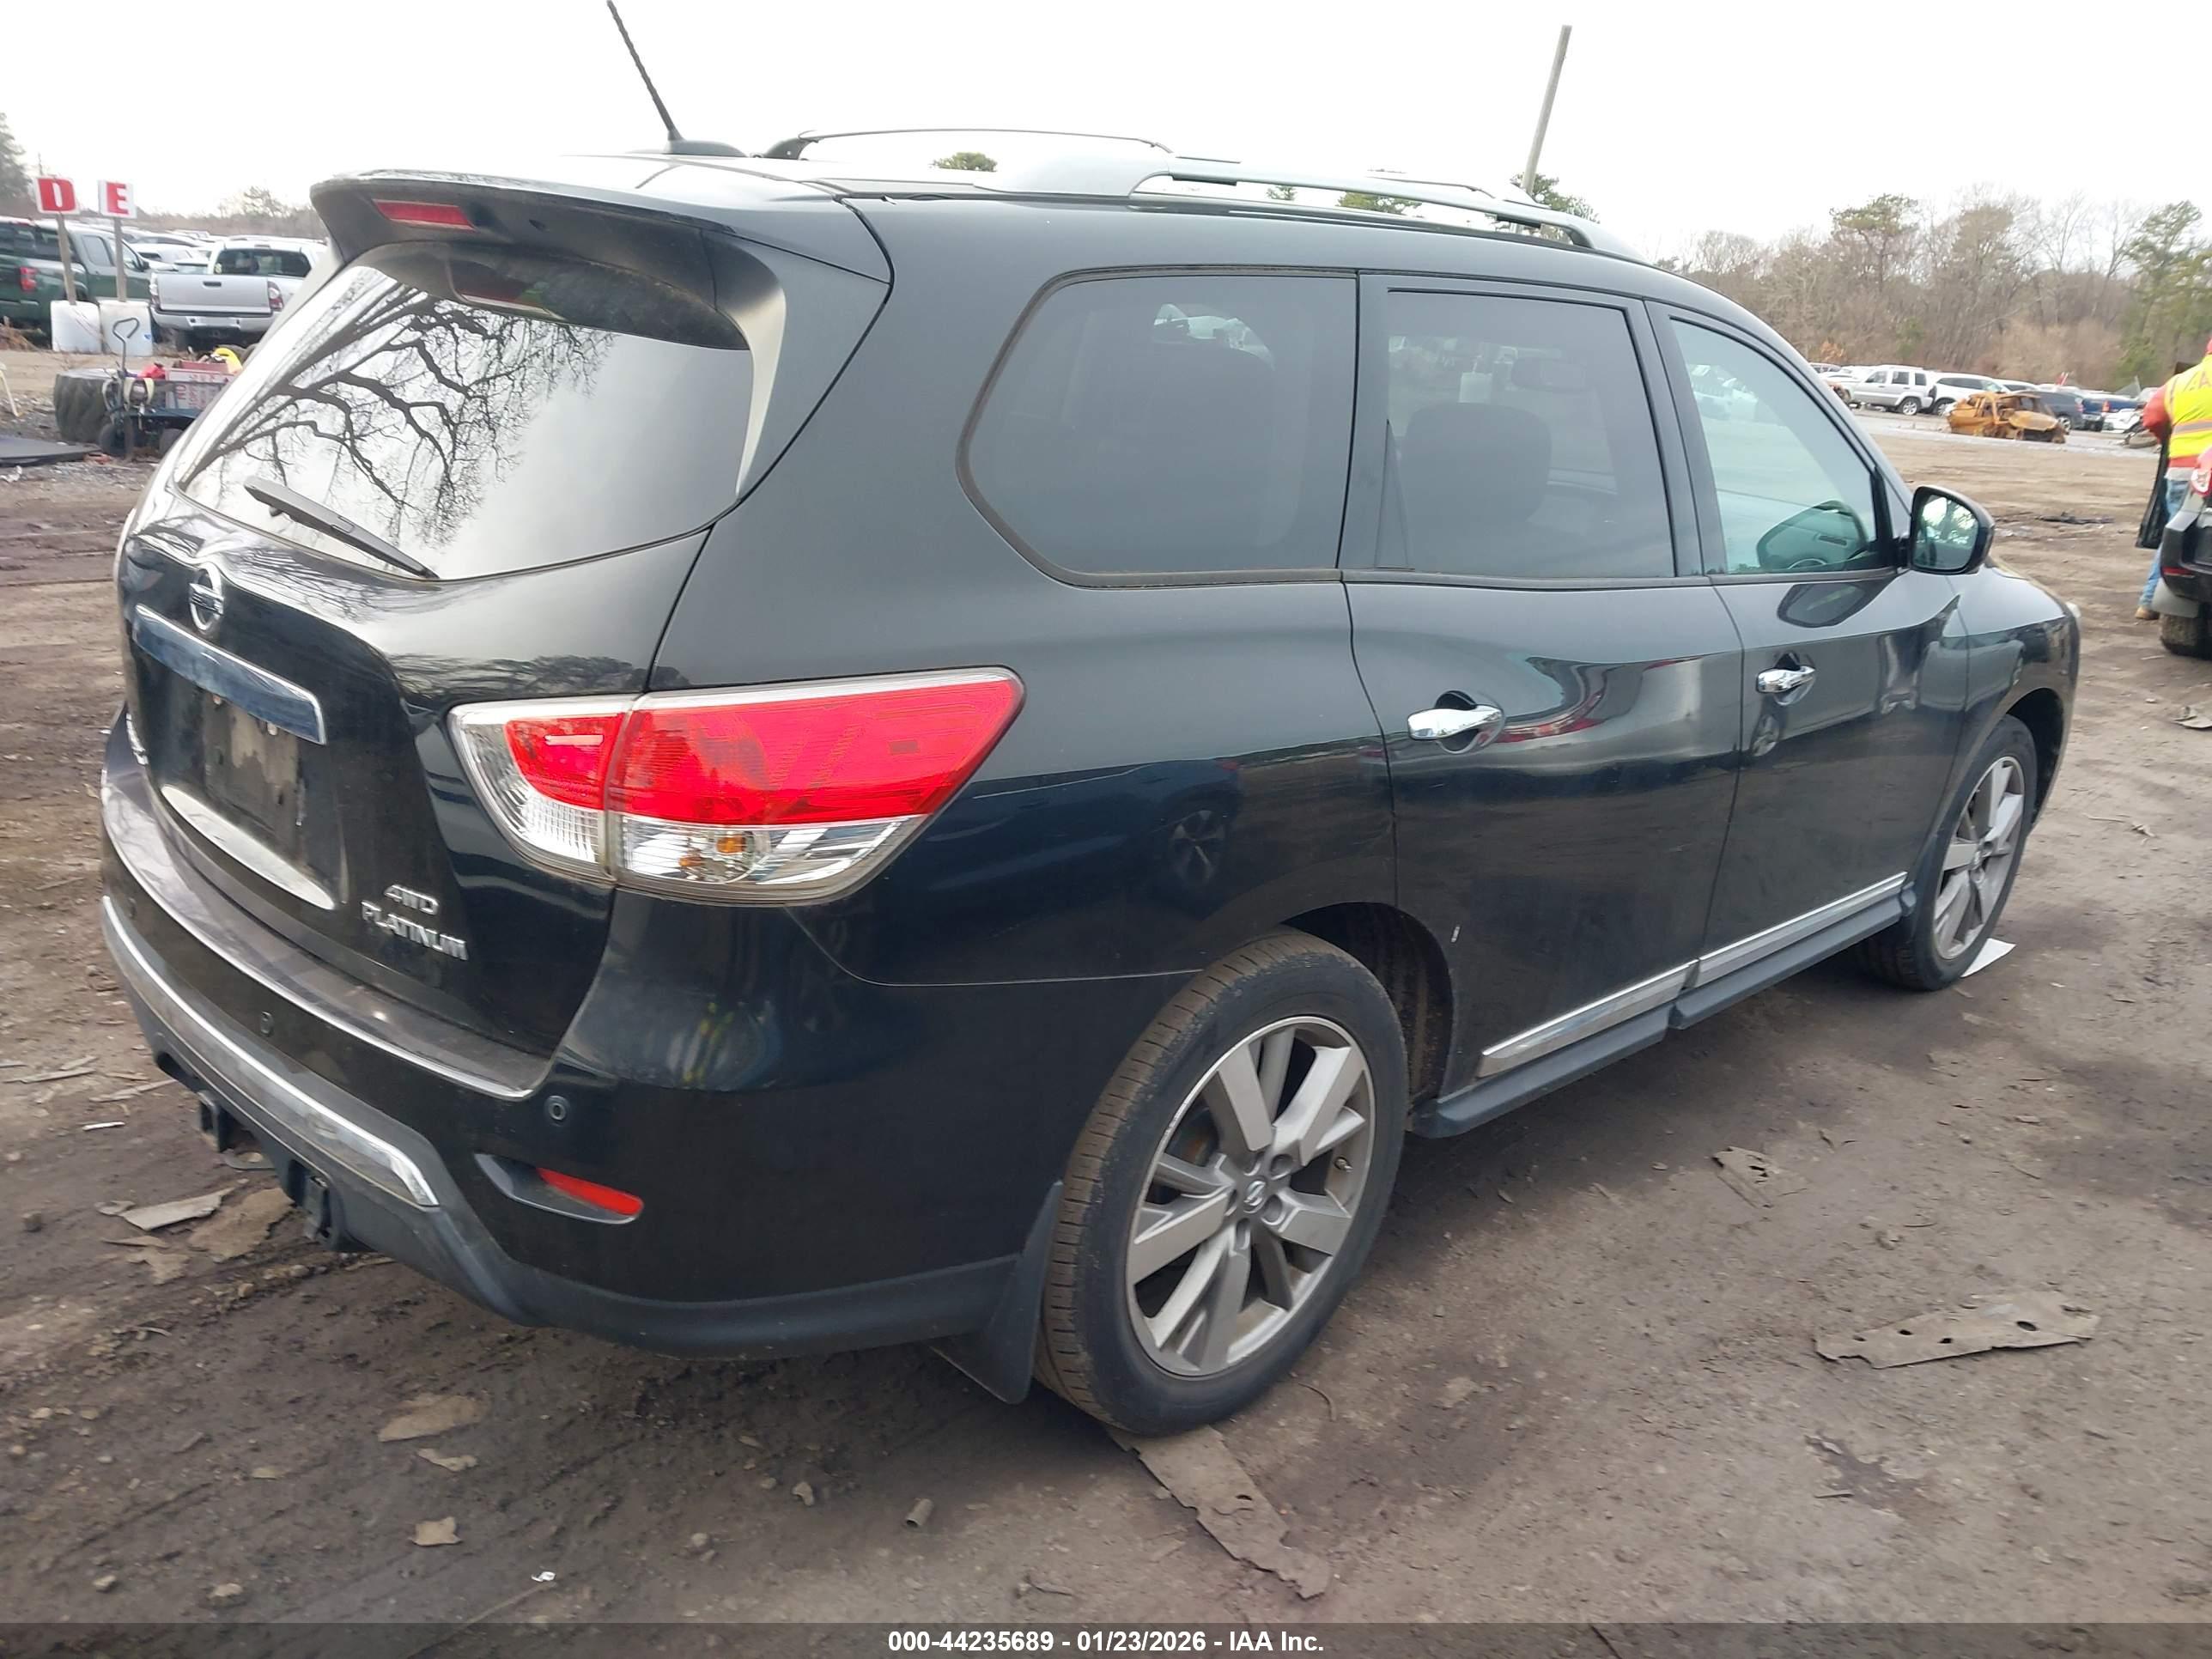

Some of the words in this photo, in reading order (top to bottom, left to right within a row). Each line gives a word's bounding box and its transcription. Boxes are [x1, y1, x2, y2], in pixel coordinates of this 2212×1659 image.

[37, 178, 76, 212] D
[106, 181, 130, 215] E
[384, 884, 439, 915] 4WD
[362, 901, 468, 960] PLATINUM
